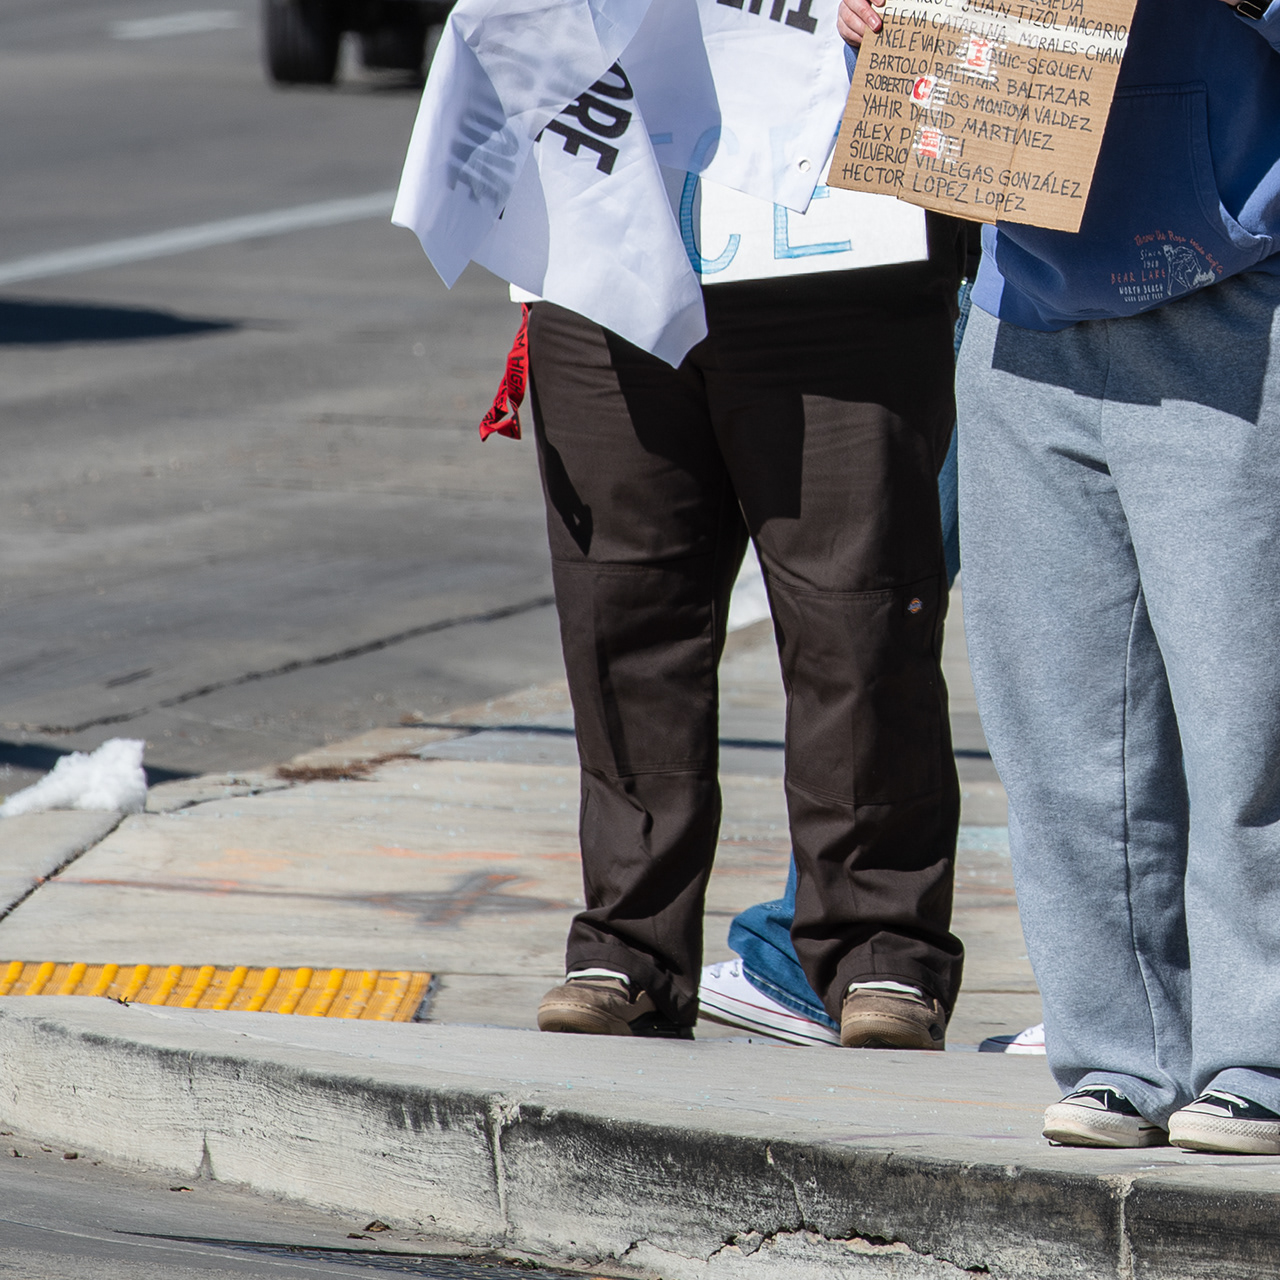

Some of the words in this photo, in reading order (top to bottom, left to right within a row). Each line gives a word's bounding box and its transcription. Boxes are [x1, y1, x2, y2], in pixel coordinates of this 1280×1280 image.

[874, 29, 908, 51] AXEL
[882, 7, 928, 29] ELENA
[931, 12, 1007, 43] CATARINA
[1019, 31, 1124, 66] MORALES-CHAN
[1016, 4, 1061, 31] TIZOL
[1064, 15, 1128, 42] MACARIO
[865, 73, 913, 95] ROBERTO
[973, 94, 1029, 121] MONTOYA
[1034, 107, 1093, 133] VALDEZ
[869, 53, 928, 75] BARTOLO
[1007, 78, 1092, 107] BALTAZAR
[853, 120, 899, 142] ALEX
[862, 93, 902, 119] YAHIR
[910, 102, 955, 129] DAVID
[961, 118, 1055, 151] MARTINEZ
[842, 163, 904, 188] HECTOR
[913, 174, 968, 204] LOPEZ
[974, 187, 1027, 212] LOPEZ
[850, 140, 908, 164] SILVERIO
[915, 155, 994, 186] VILLEGAS
